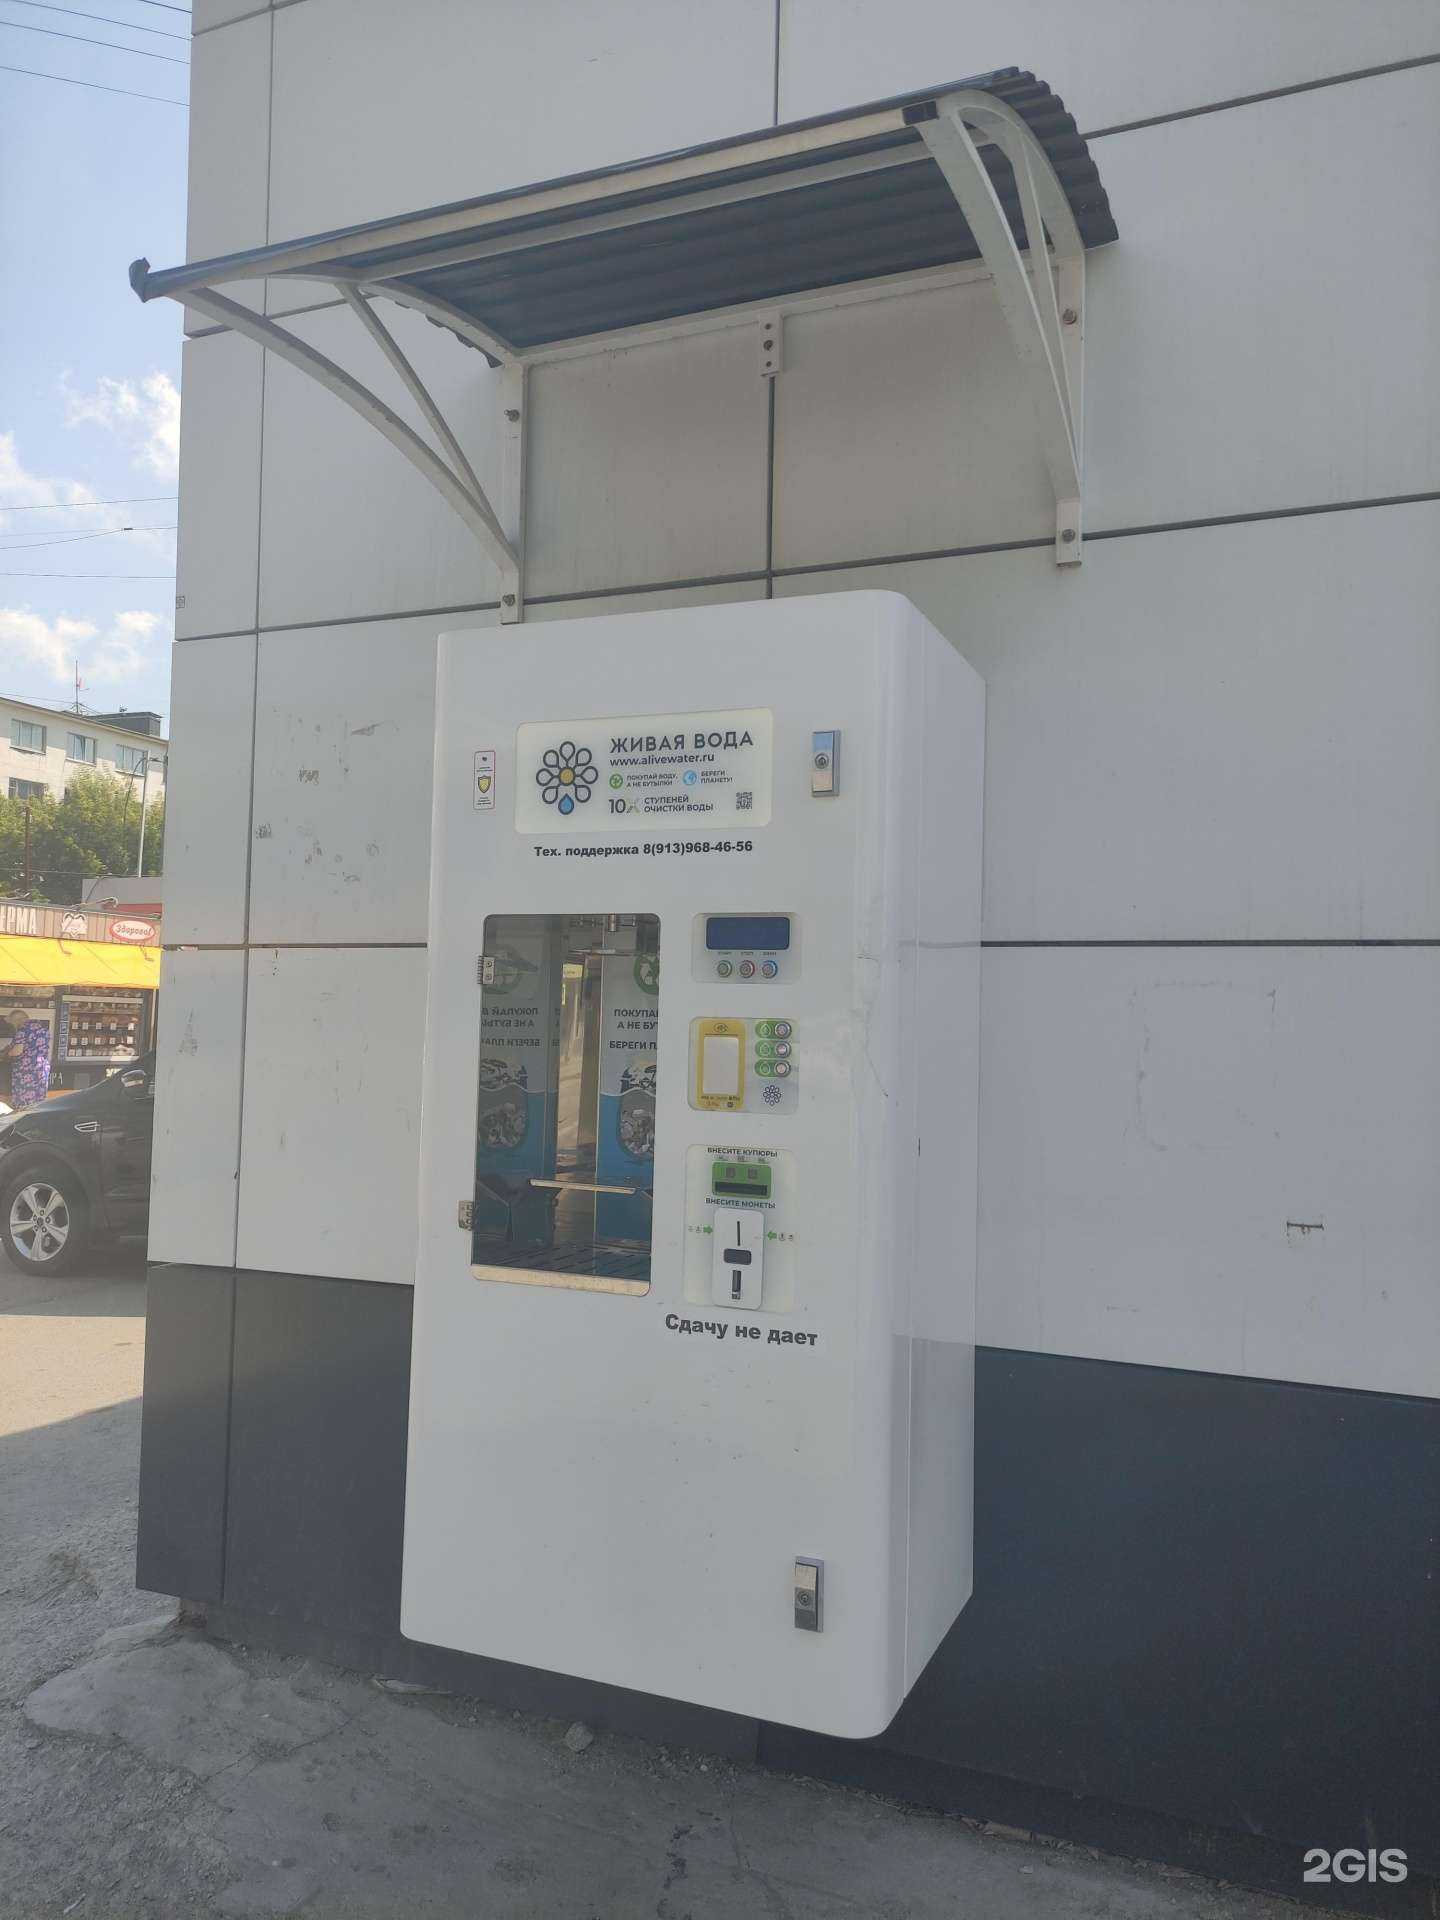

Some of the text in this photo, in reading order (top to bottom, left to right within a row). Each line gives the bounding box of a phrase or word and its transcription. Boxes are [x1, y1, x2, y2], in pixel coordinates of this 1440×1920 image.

[610, 731, 754, 753] ЖИВАЯ ВОДА
[609, 753, 715, 766] www.alivewater.ru
[644, 795, 689, 804] СТУПЕНЕЙ
[644, 804, 714, 813] ОЧИСТКИ ВОДЫ
[534, 840, 753, 859] Тех. поддержка 8(913)968-46-56
[627, 1021, 641, 1030] НЕ
[609, 1040, 647, 1050] БЕРЕГИ
[707, 1147, 778, 1158] ВНЕСИТЕ КУПЮРЫ
[705, 1197, 776, 1209] ВНЕСИТЕ МОНЕТЫ
[665, 1313, 818, 1346] Сдачу не дает
